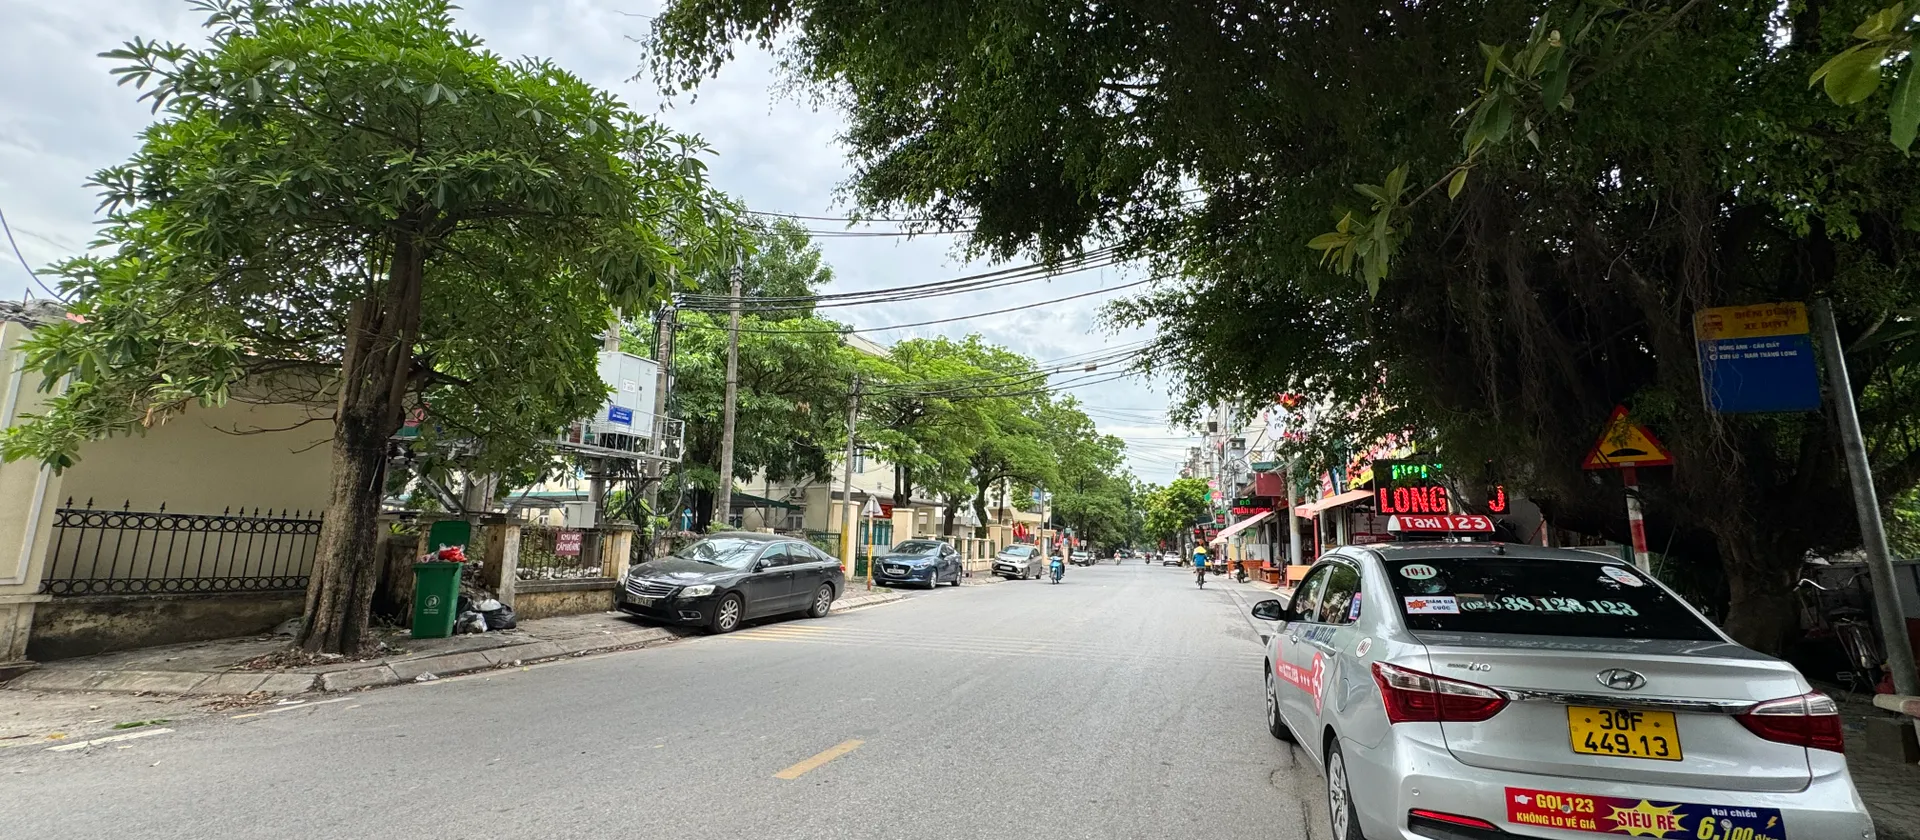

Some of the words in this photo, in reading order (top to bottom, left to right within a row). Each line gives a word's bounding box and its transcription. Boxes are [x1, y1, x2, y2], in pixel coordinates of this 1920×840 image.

[1380, 486, 1447, 513] LONG
[1400, 516, 1442, 528] Taxi
[1443, 516, 1488, 530] 123
[1404, 567, 1432, 576] 1041
[1598, 709, 1644, 732] 30F
[1584, 732, 1670, 756] 449.13
[1536, 794, 1561, 812] GỌI
[1566, 798, 1594, 813] 123
[1710, 808, 1728, 816] Hai
[1516, 810, 1549, 825] KHÔNG
[1552, 817, 1563, 826] LO
[1580, 818, 1597, 830] GIÁ
[1616, 810, 1652, 829] SIÊU
[1656, 810, 1677, 830] RẺ
